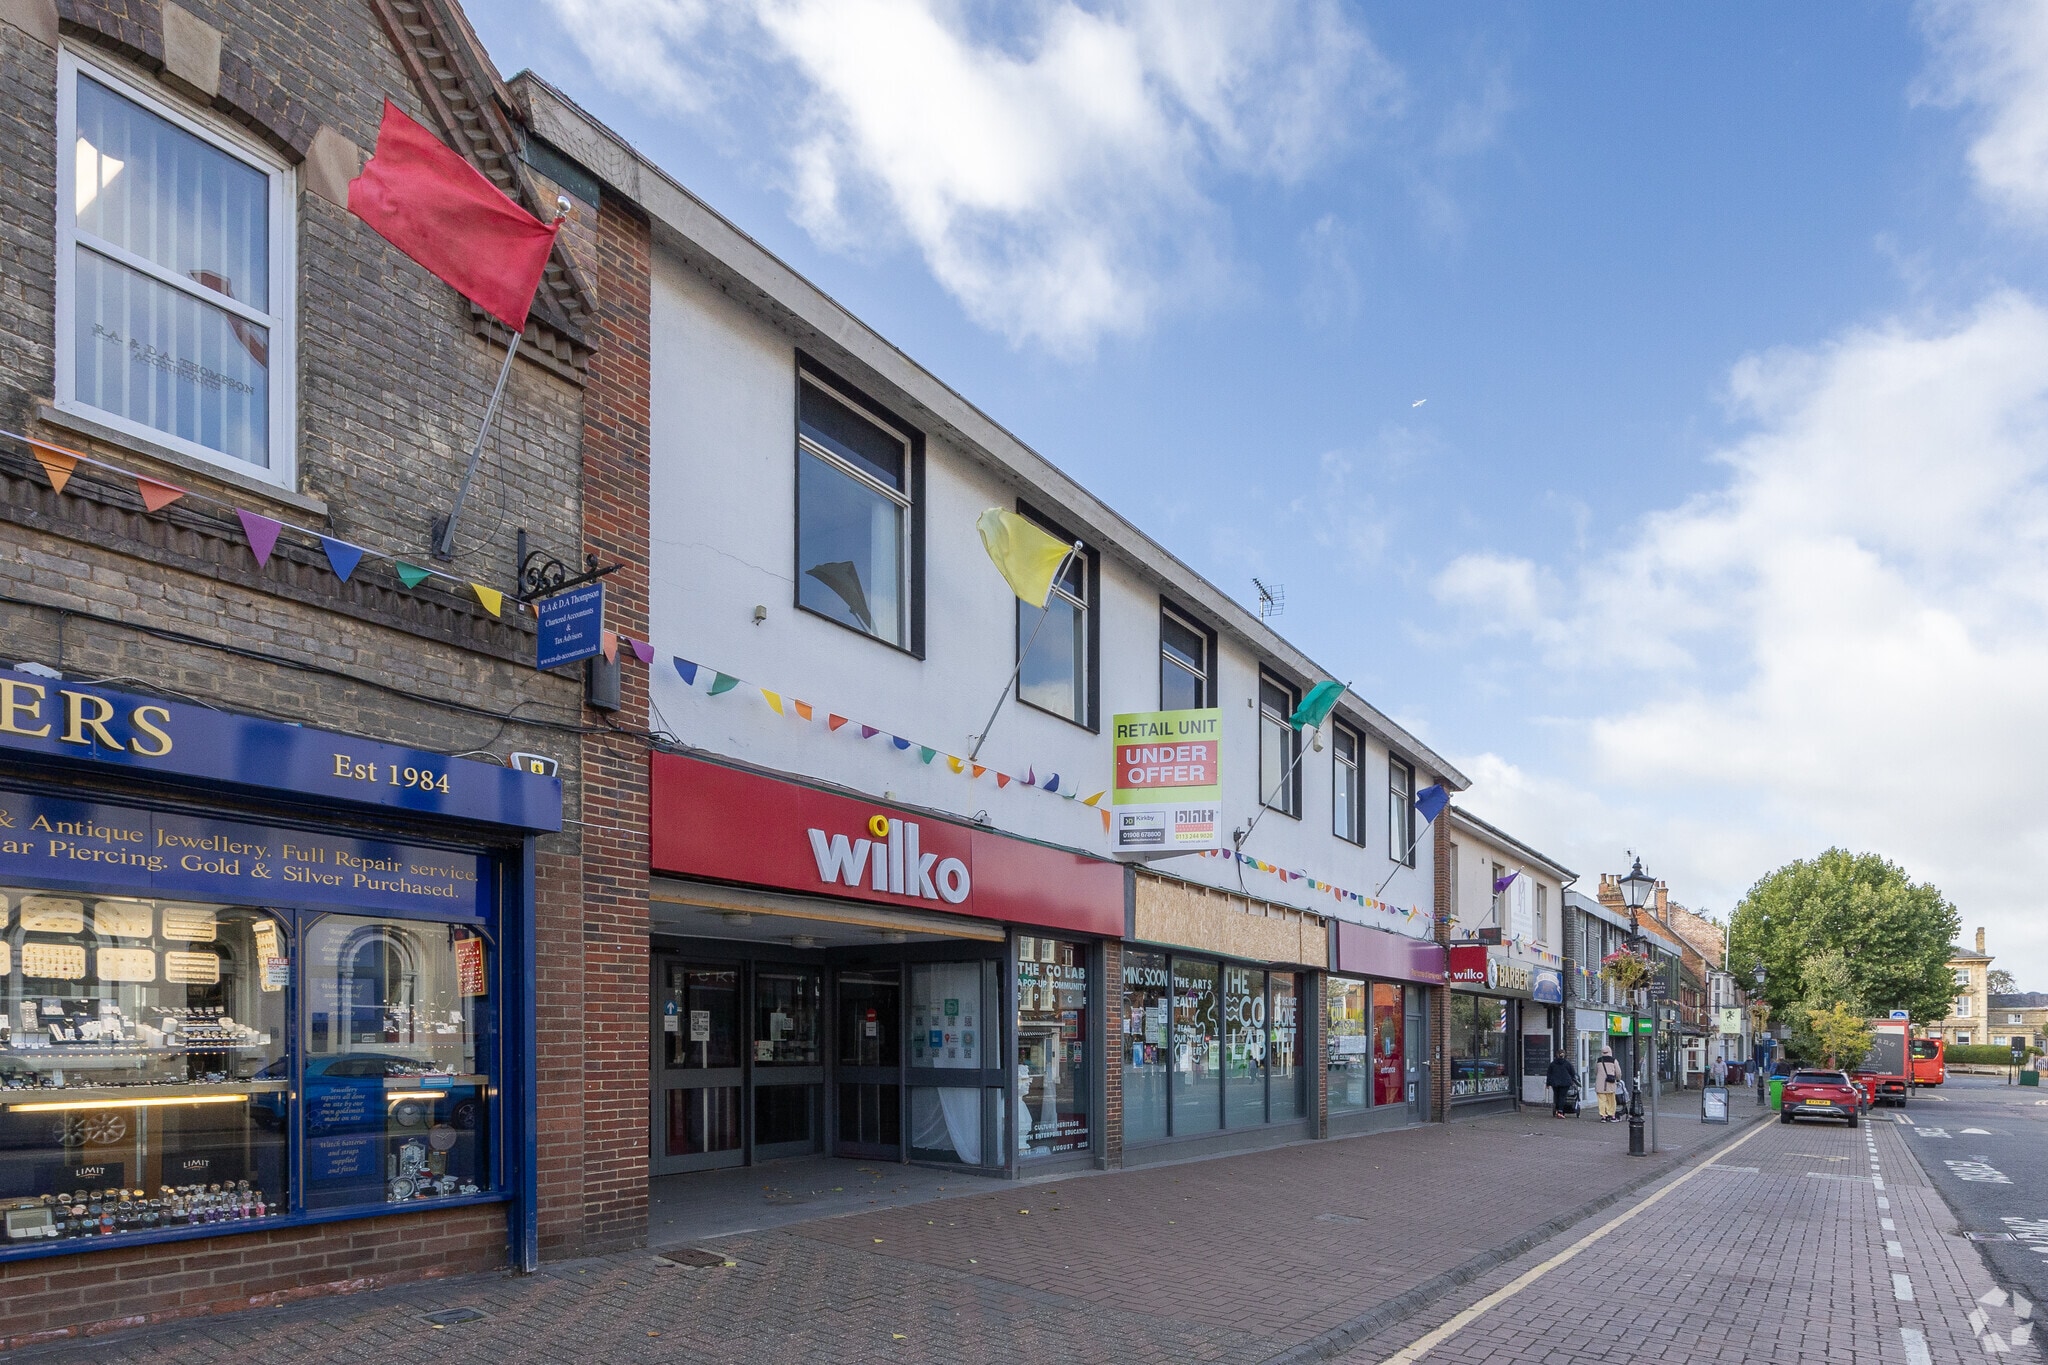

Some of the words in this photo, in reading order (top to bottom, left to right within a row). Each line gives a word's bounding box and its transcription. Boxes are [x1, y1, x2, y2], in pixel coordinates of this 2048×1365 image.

[133, 351, 222, 391] ACCOUNTANTS
[180, 357, 255, 396] THOMPSON
[552, 601, 558, 610] &
[571, 590, 600, 605] Thompson
[545, 615, 567, 627] Chartered
[567, 608, 594, 621] Accountants
[565, 623, 572, 632] &
[554, 637, 563, 645] Tax
[1117, 722, 1174, 738] RETAIL
[1178, 719, 1217, 735] UNIT
[1126, 745, 1207, 765] UNDER
[333, 753, 378, 782] Est
[388, 764, 450, 794] 1984
[1128, 765, 1205, 784] OFFER
[28, 814, 144, 844] Antique
[156, 828, 272, 859] Jewellery.
[282, 844, 324, 864] Full
[335, 851, 403, 873] Repair
[410, 863, 479, 882] service.
[807, 814, 971, 904] wilko
[48, 839, 168, 872] Piercing.
[180, 854, 241, 876] Gold
[250, 862, 272, 879] &
[283, 865, 344, 886] Silver
[353, 874, 460, 898] Purchased.
[1018, 962, 1039, 976] THE
[1046, 964, 1062, 978] CO
[1064, 967, 1086, 979] LAB
[1145, 969, 1168, 987] SOON
[1453, 968, 1484, 980] wilko
[1499, 964, 1529, 991] BARBER
[1022, 979, 1047, 989] POP-UP
[1050, 980, 1087, 991] COMMUNITY
[1174, 977, 1189, 988] THE
[1192, 979, 1212, 990] ARTS
[1226, 967, 1250, 995] THE
[1239, 996, 1265, 1028] CO
[1274, 1007, 1296, 1027] DONE
[1174, 1034, 1186, 1043] OUR
[1232, 1028, 1266, 1060] LAB
[1274, 1028, 1296, 1053] YET
[321, 1094, 341, 1102] repairs
[344, 1100, 352, 1108] by
[1034, 1123, 1055, 1131] CULTURE
[1056, 1120, 1079, 1129] HERITAGE
[1035, 1130, 1062, 1139] ENTERPRISE
[1065, 1127, 1089, 1136] EDUCATION
[342, 1139, 367, 1147] batteries
[1052, 1143, 1074, 1152] AUGUST
[331, 1156, 357, 1165] supplied
[341, 1148, 359, 1156] straps
[76, 1167, 105, 1178] LIMIT
[183, 1159, 210, 1169] LIMIT
[327, 1166, 340, 1174] and
[339, 1165, 358, 1175] fitted
